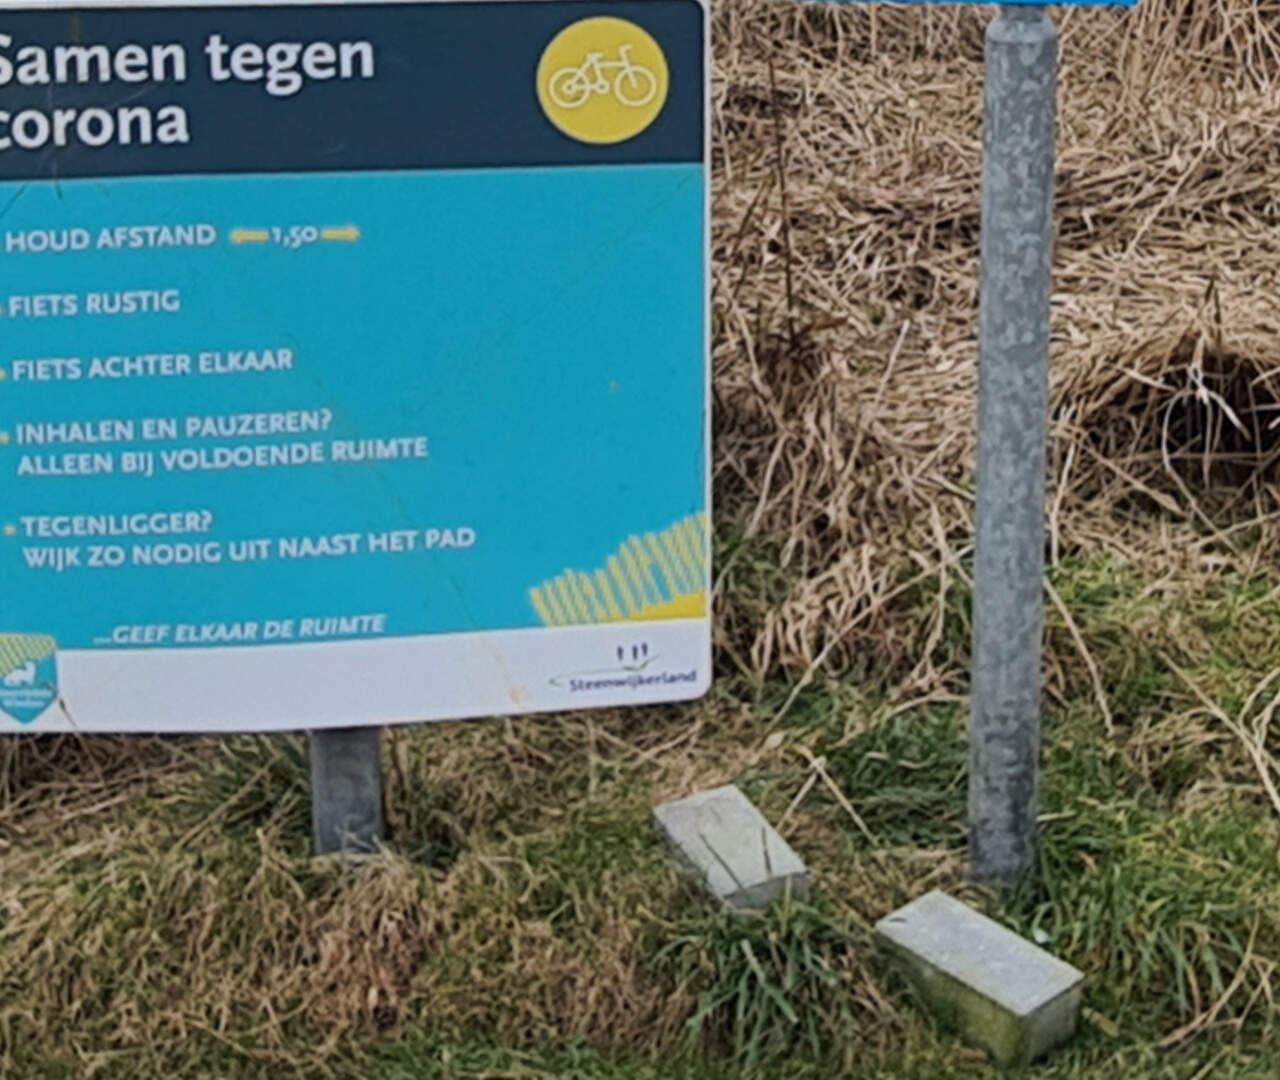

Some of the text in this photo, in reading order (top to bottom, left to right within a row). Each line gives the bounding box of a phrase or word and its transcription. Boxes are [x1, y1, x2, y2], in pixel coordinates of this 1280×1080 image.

[204, 34, 375, 96] tegen
[6, 224, 319, 253] HOUD AFSTAND 1,50
[9, 290, 181, 317] FIETS RUSTIG
[13, 348, 294, 381] FIETS ACHTER ELKAAR
[17, 409, 333, 445] INHALEN EN PAUZEREN?
[17, 437, 428, 477] ALLEEN BIJ VOLDOENDE RUIMTE
[22, 511, 213, 538] TEGENLIGGER?
[23, 527, 476, 572] WIJK ZO NODIG UIT NAAST HET PAD
[175, 621, 258, 643] ELKAAR
[264, 620, 294, 639] DE
[299, 613, 388, 637] RUIMTE
